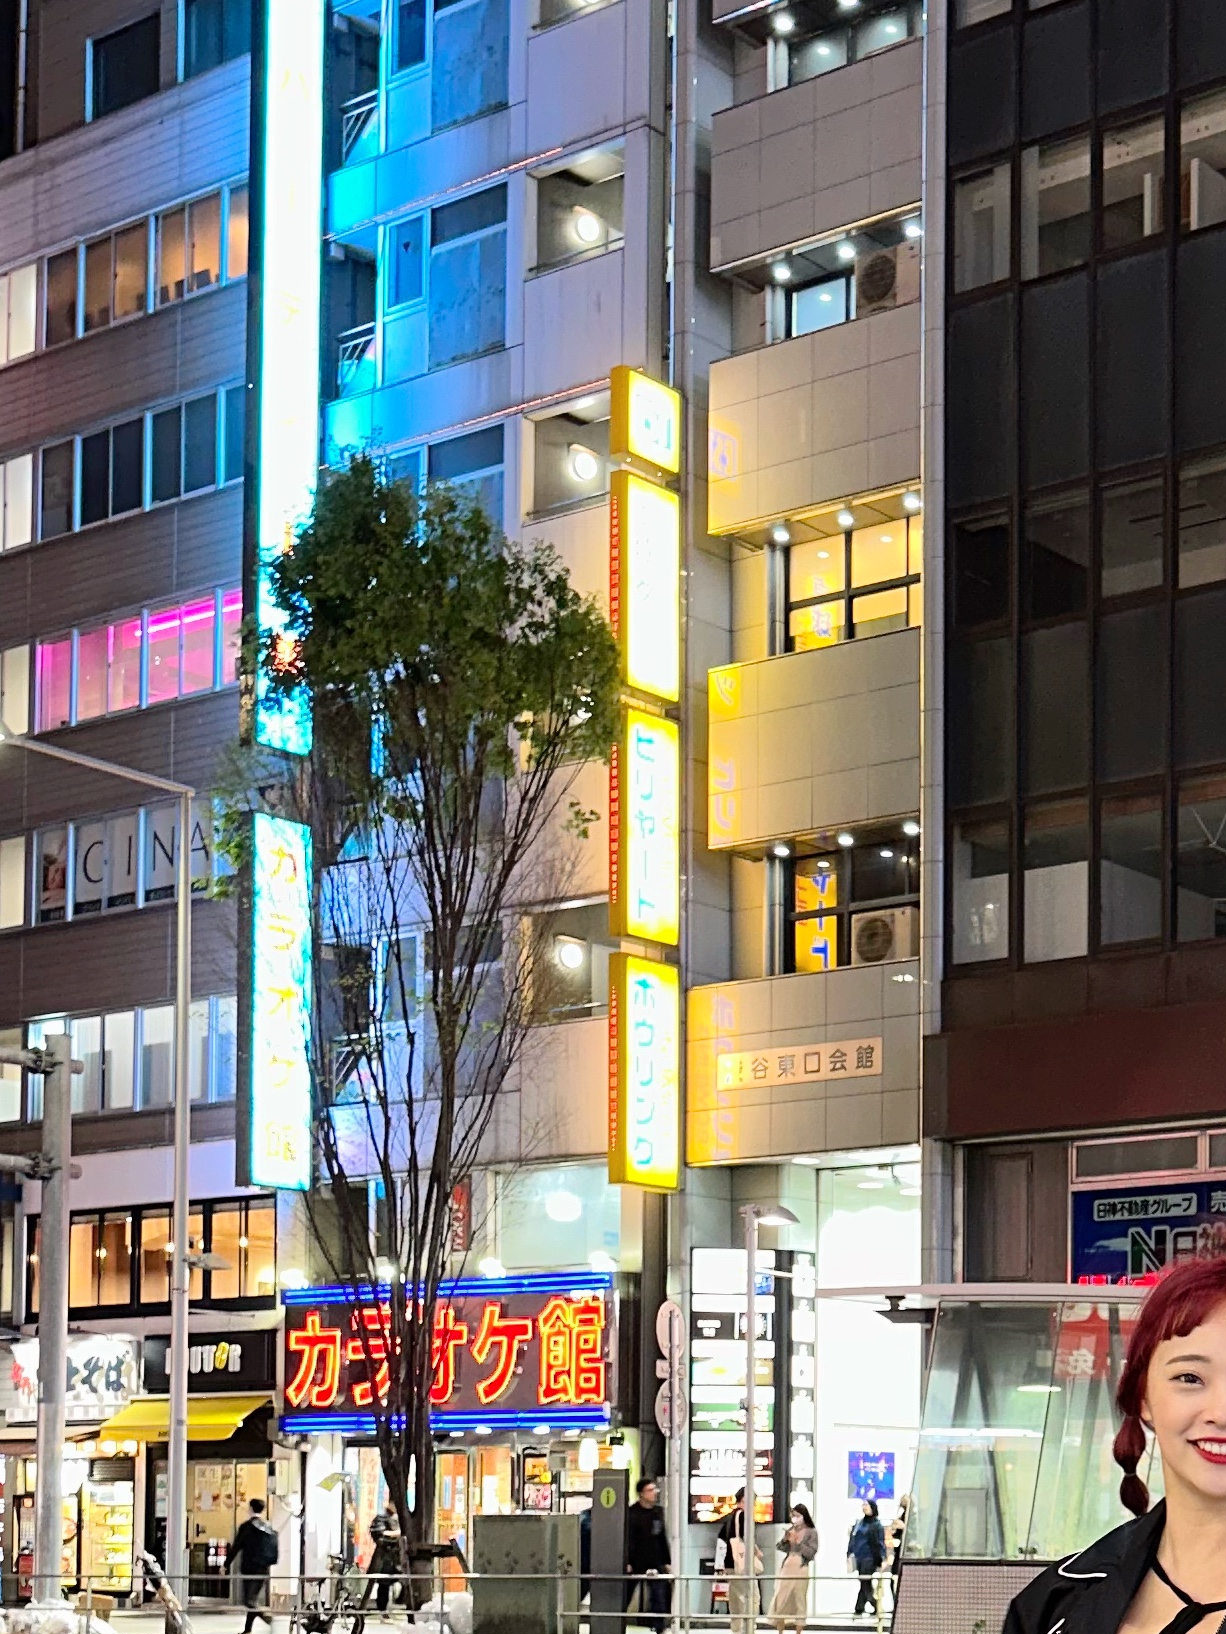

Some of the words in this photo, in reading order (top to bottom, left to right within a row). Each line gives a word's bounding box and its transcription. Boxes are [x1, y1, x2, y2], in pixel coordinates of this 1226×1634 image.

[737, 1044, 875, 1083] 谷東口会館
[165, 1341, 241, 1375] UTOR
